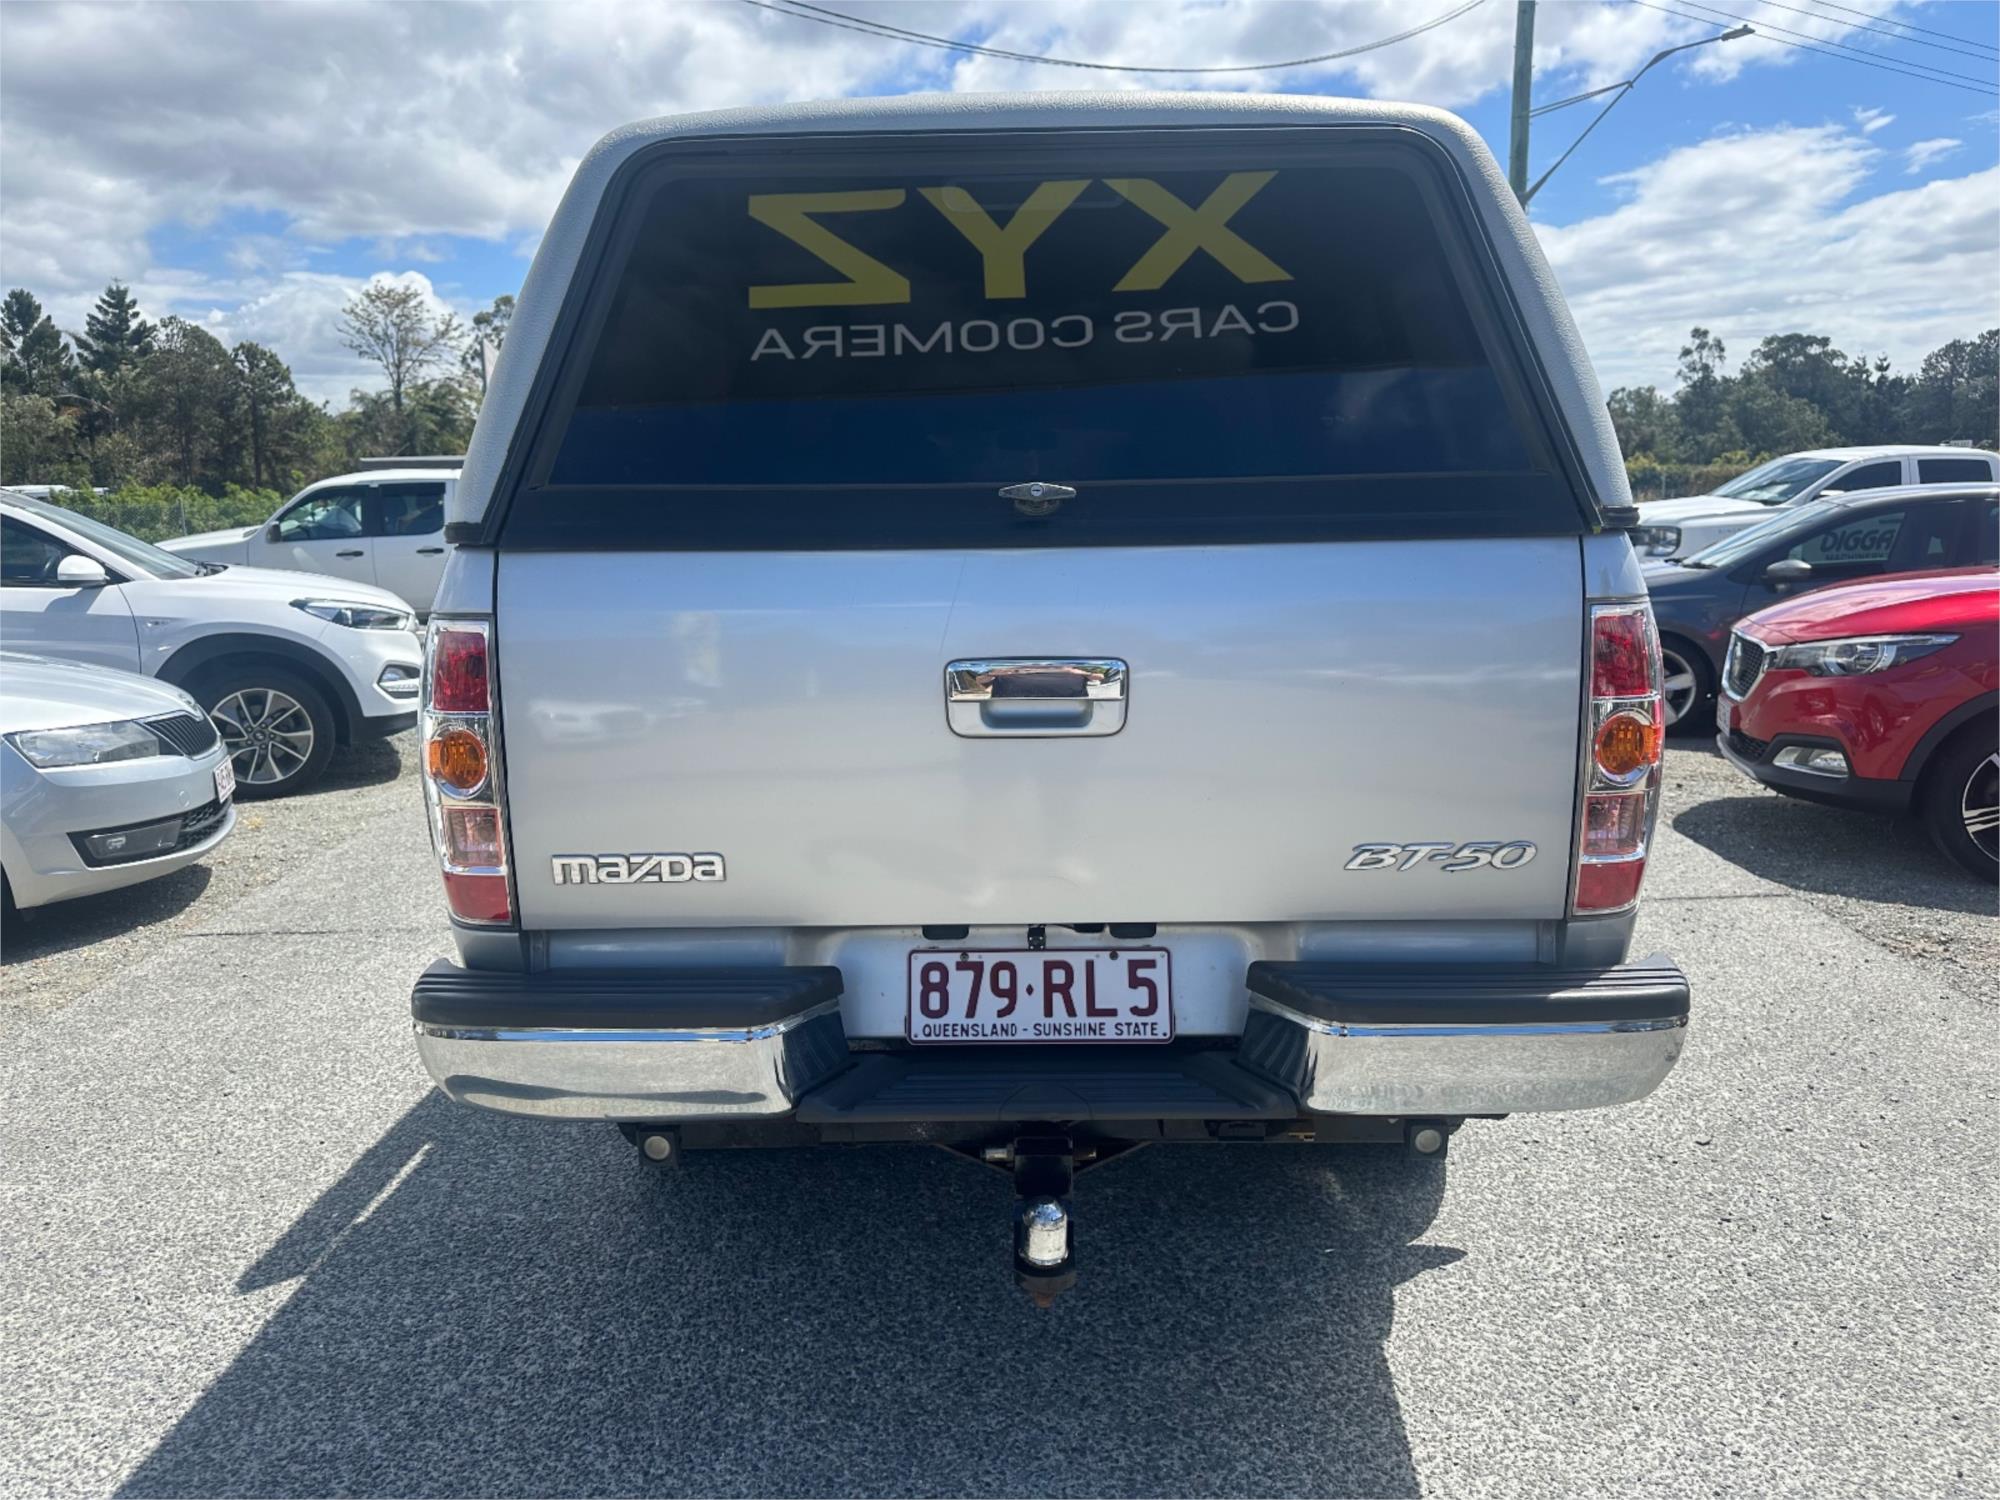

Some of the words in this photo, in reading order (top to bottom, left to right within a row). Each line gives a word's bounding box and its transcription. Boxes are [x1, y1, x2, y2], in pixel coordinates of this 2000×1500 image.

[1820, 529, 1896, 552] DIGGA
[1343, 840, 1538, 872] BT-50
[922, 1023, 1018, 1038] QUEENSLAND
[1033, 1022, 1107, 1037] SUNSHINE
[1114, 1022, 1159, 1037] STATE
